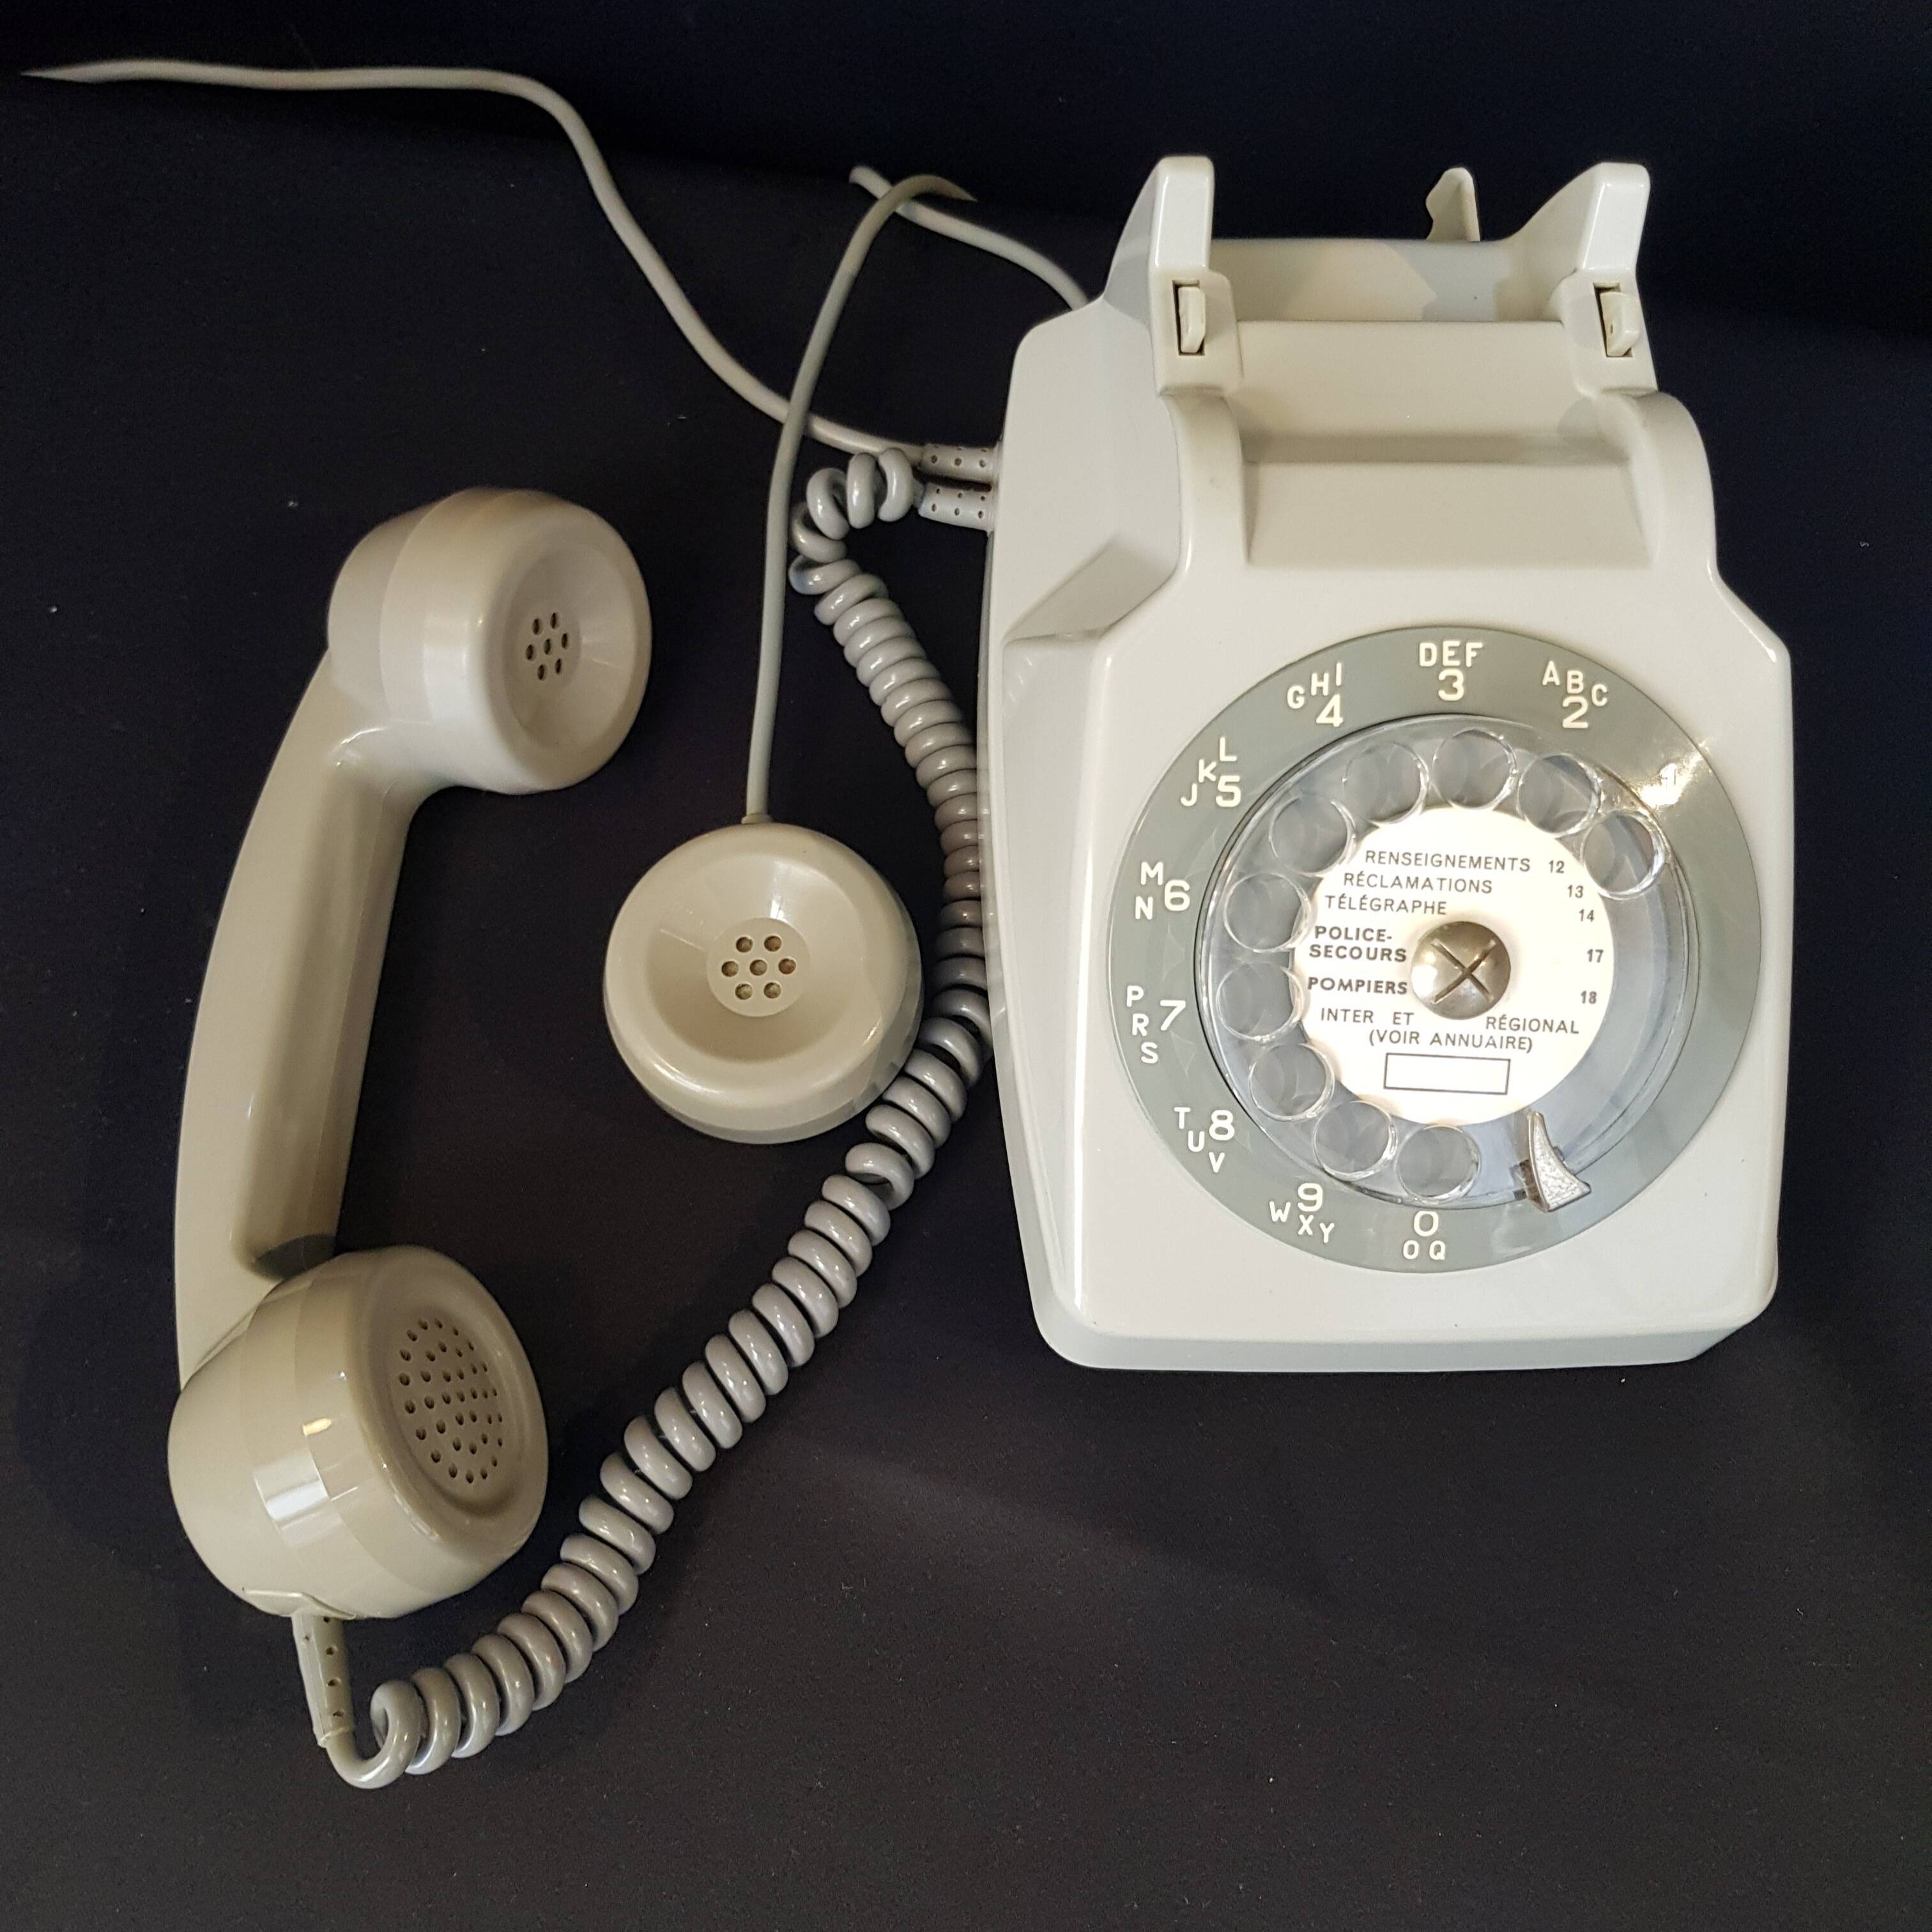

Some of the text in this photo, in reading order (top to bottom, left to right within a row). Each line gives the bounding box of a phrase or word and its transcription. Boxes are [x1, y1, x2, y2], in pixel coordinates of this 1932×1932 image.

[1419, 640, 1483, 668] DEF
[1438, 668, 1465, 701] 3
[1315, 694, 1344, 727] 4
[1562, 696, 1589, 728] 2
[1215, 775, 1241, 808] 5
[1365, 850, 1565, 873] RENSEIGNEMENTS 12
[1165, 879, 1191, 912] 6
[1344, 872, 1583, 898] RÉCLAMATIONS 13
[1325, 894, 1595, 922] TÉLÉGRAPHE 14
[1315, 926, 1392, 942] POLICE-
[1309, 944, 1604, 963] SECOURS 17
[1307, 977, 1597, 1004] POMPIERS 18
[1160, 999, 1186, 1031] 7
[1321, 1008, 1579, 1034] INTER ET RÉGIONAL
[1368, 1029, 1533, 1054] (VOIR ANNUAIRE)
[1209, 1109, 1236, 1141] 8
[1297, 1183, 1323, 1212] 9
[1413, 1210, 1439, 1237] 0
